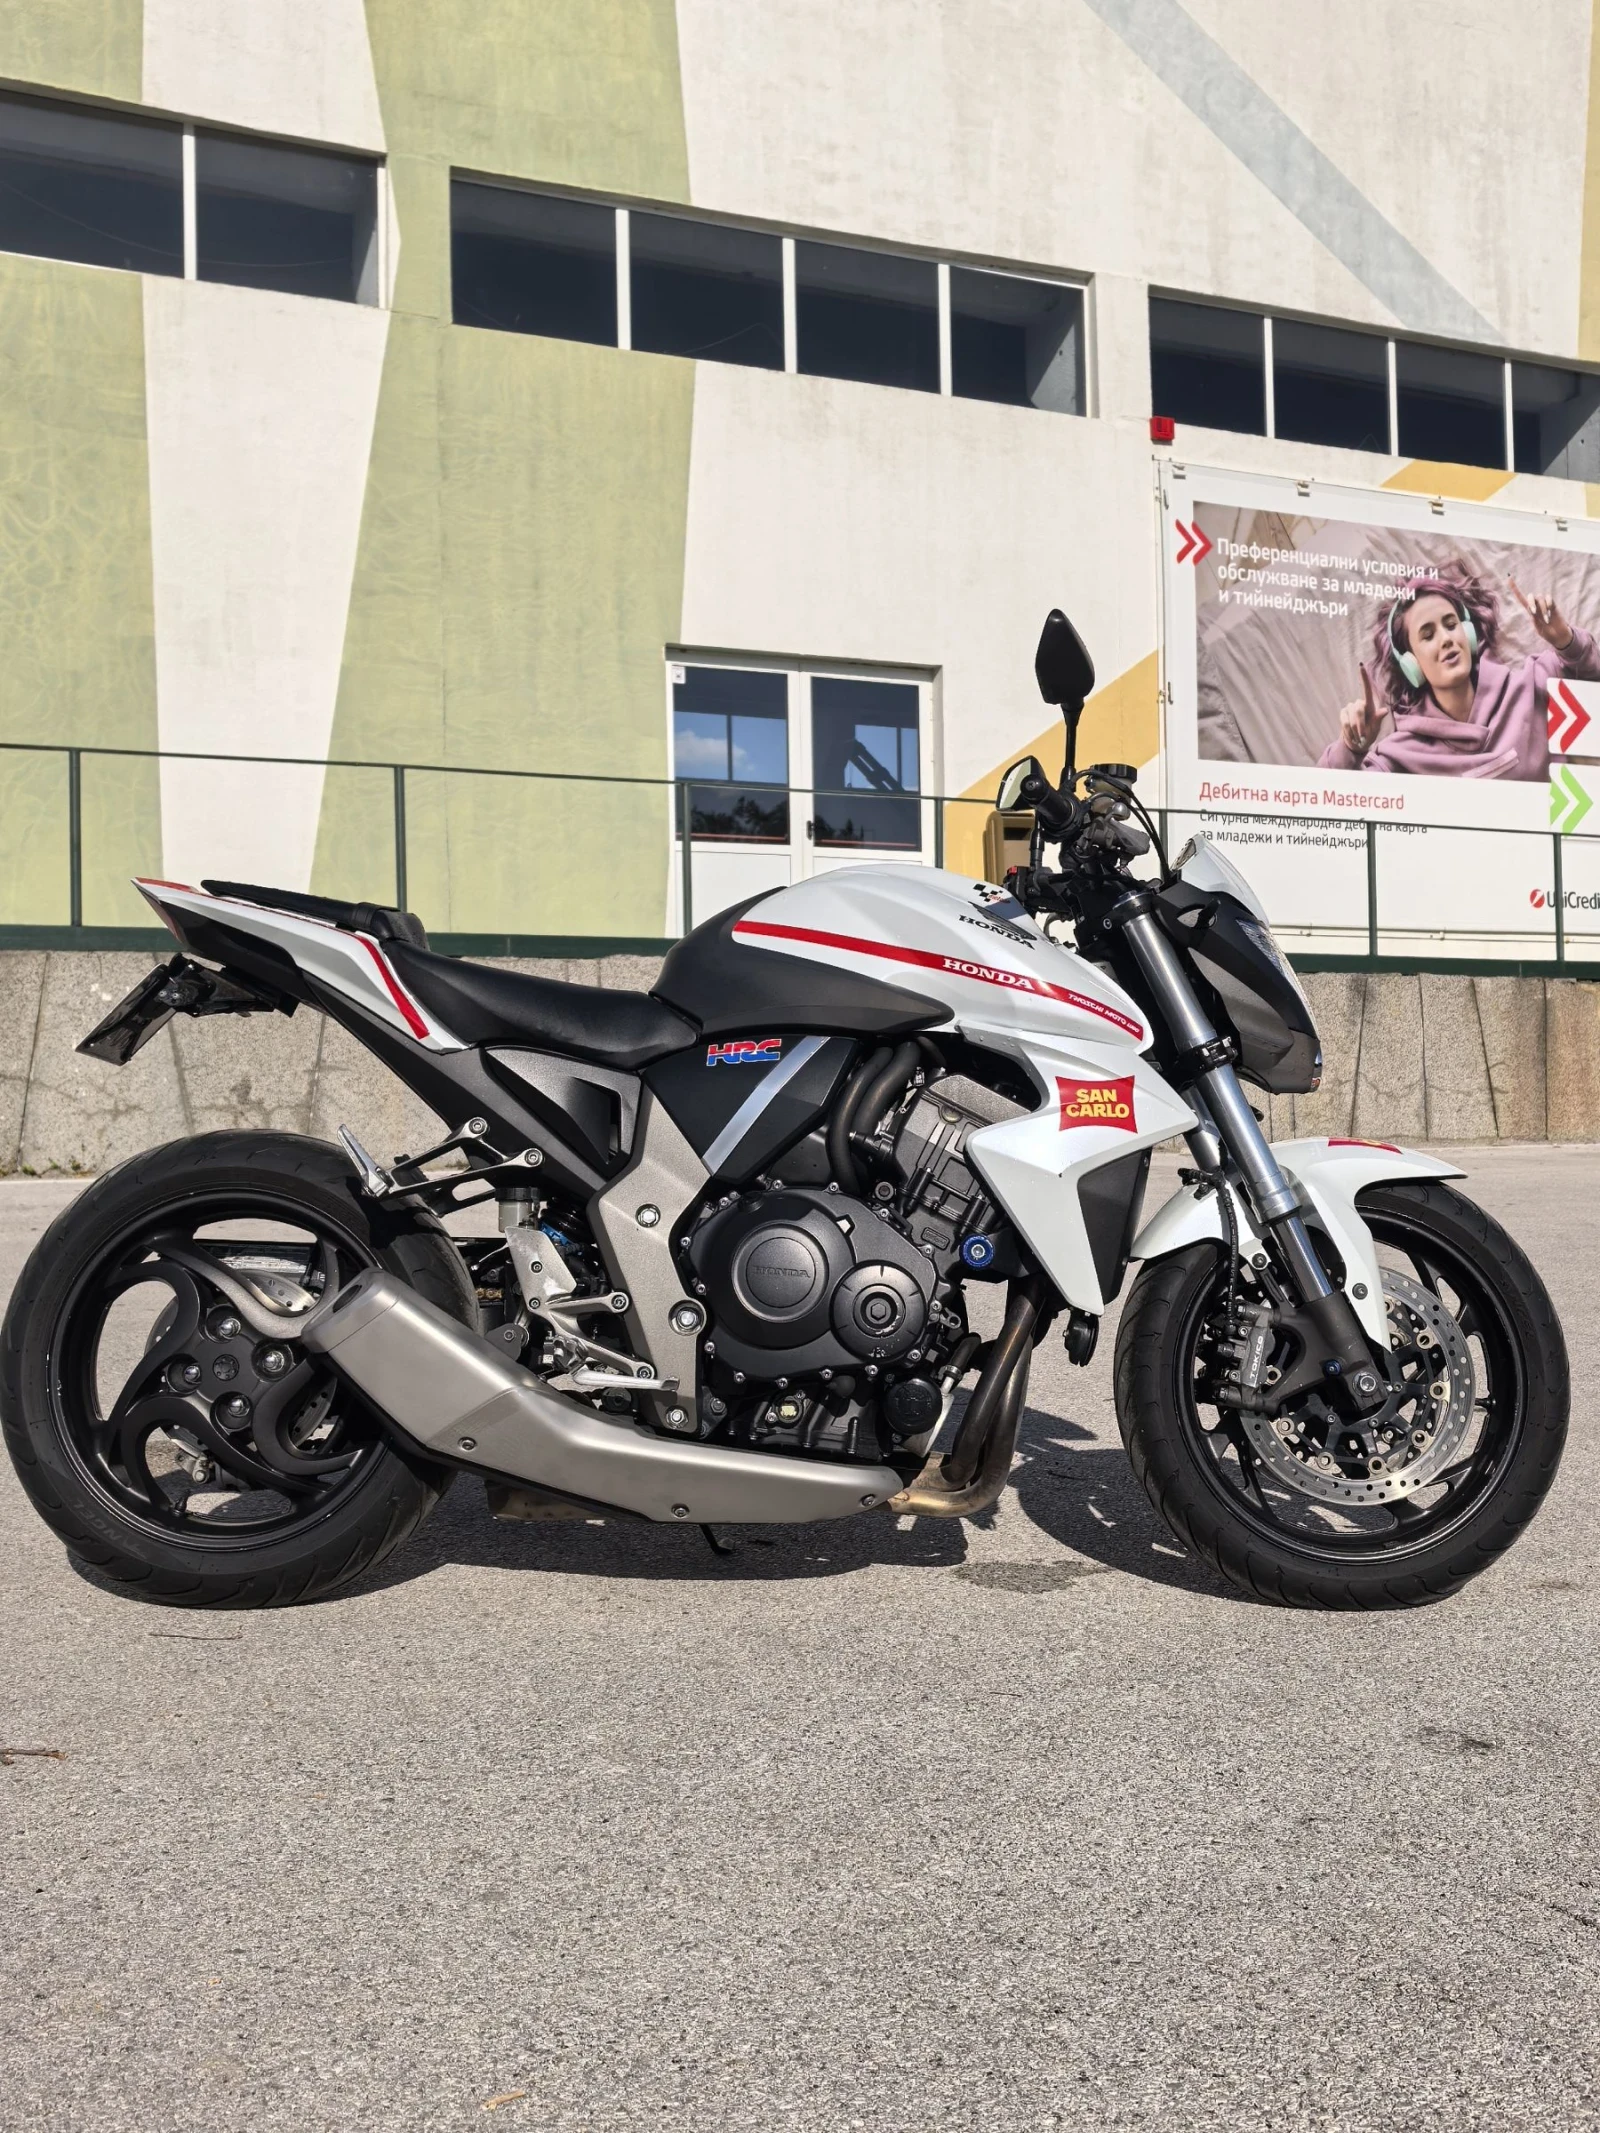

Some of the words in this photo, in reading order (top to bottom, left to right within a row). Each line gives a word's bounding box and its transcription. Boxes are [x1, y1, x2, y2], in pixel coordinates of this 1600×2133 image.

[1217, 538, 1358, 571] Преференциални
[1362, 559, 1425, 578] условия
[1429, 567, 1439, 581] и
[1217, 563, 1318, 590] обслужване
[1322, 577, 1340, 592] за
[1344, 580, 1416, 600] младежи
[1219, 589, 1229, 603] и
[1233, 588, 1348, 619] тийнейджъри
[1199, 782, 1268, 802] Дебитна
[1274, 790, 1318, 807] карта
[1323, 790, 1404, 810] Mastercard
[1217, 831, 1272, 845] младежи
[1276, 834, 1283, 844] и
[1547, 891, 1600, 910] UiCredi
[959, 914, 1036, 950] HONDA
[942, 958, 1036, 991] HONDA
[1104, 1010, 1127, 1026] MOTO
[706, 1039, 782, 1067] HRC
[1076, 1088, 1118, 1103] SAN
[1066, 1103, 1130, 1119] CARLO
[752, 1265, 811, 1279] HONDA
[1249, 1335, 1264, 1380] TOKICO
